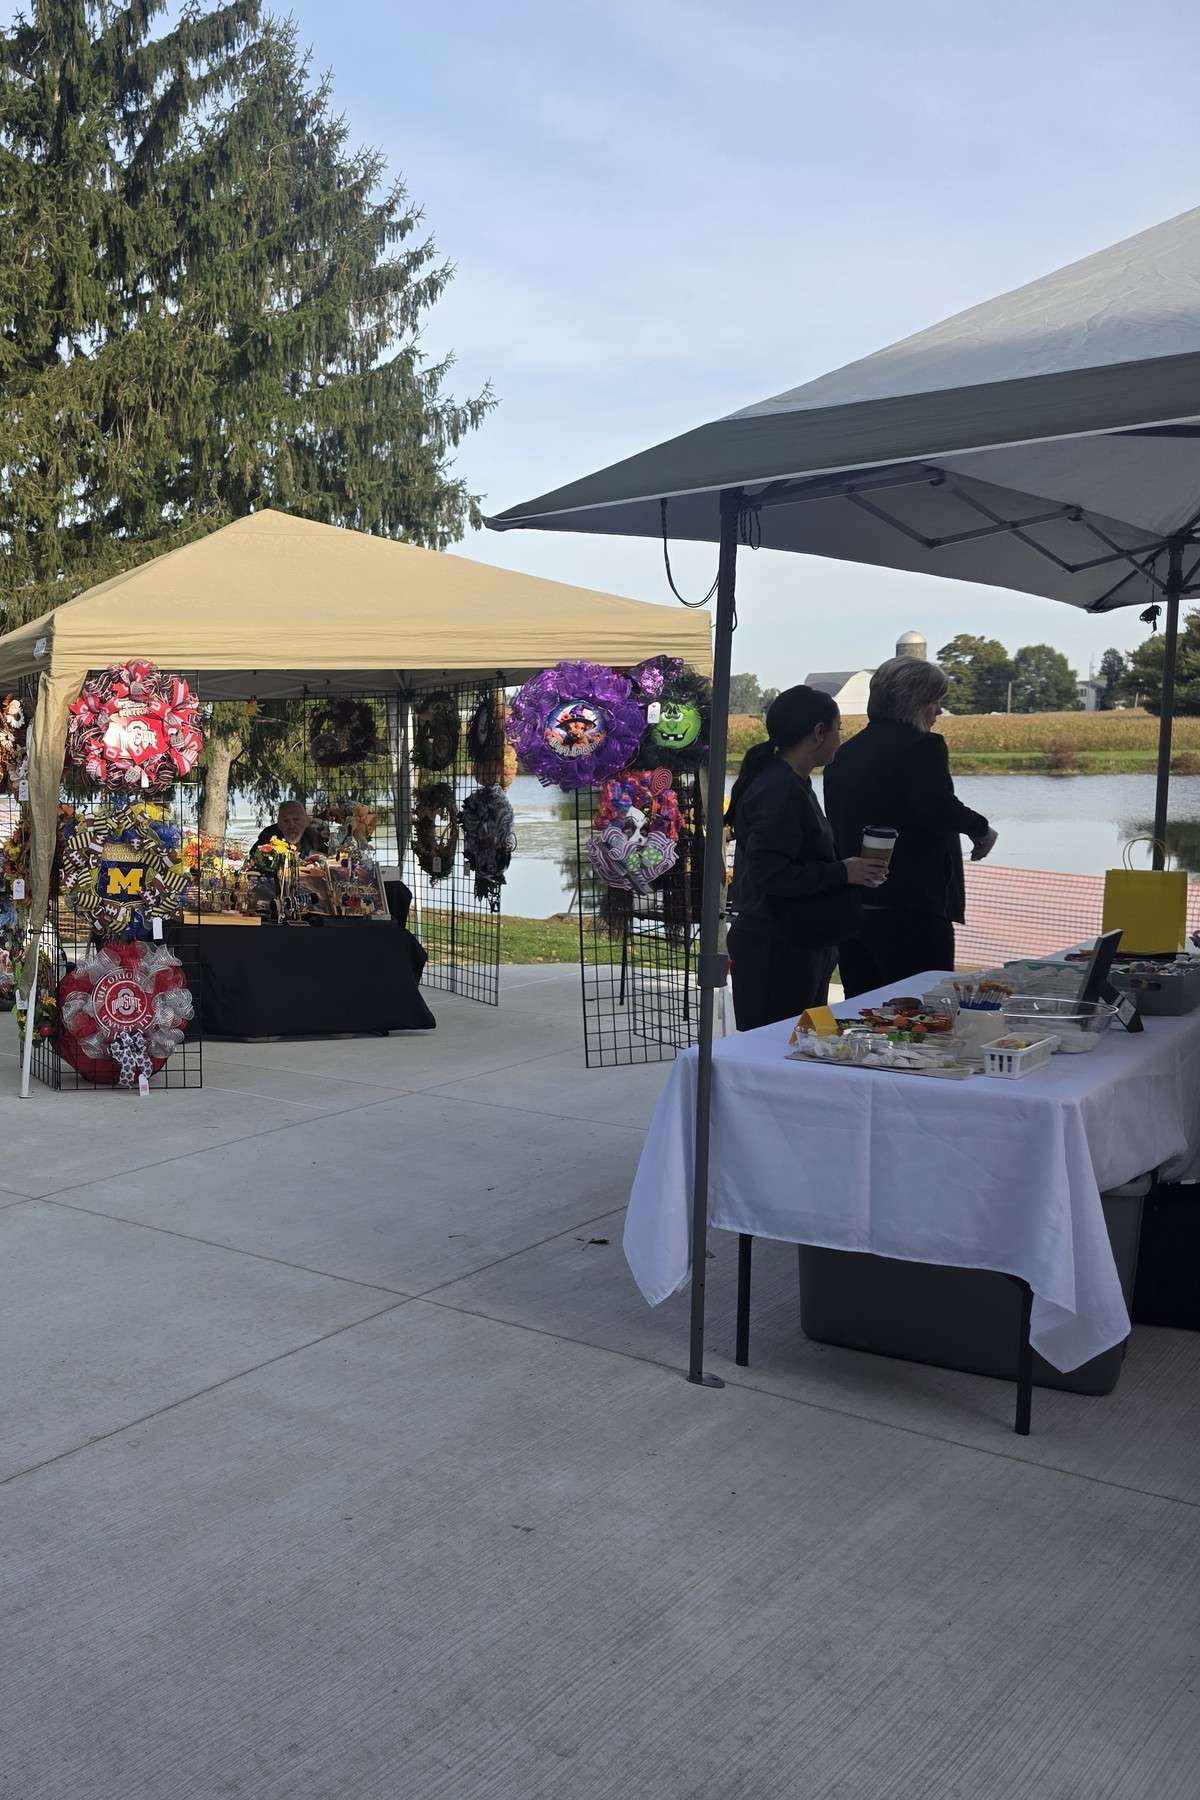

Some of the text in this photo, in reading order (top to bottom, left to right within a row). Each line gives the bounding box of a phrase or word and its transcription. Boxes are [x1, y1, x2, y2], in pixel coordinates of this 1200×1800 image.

[107, 868, 144, 895] M
[96, 983, 108, 1003] THE
[107, 971, 133, 985] OHIO
[102, 1012, 152, 1032] UNIVERITY
